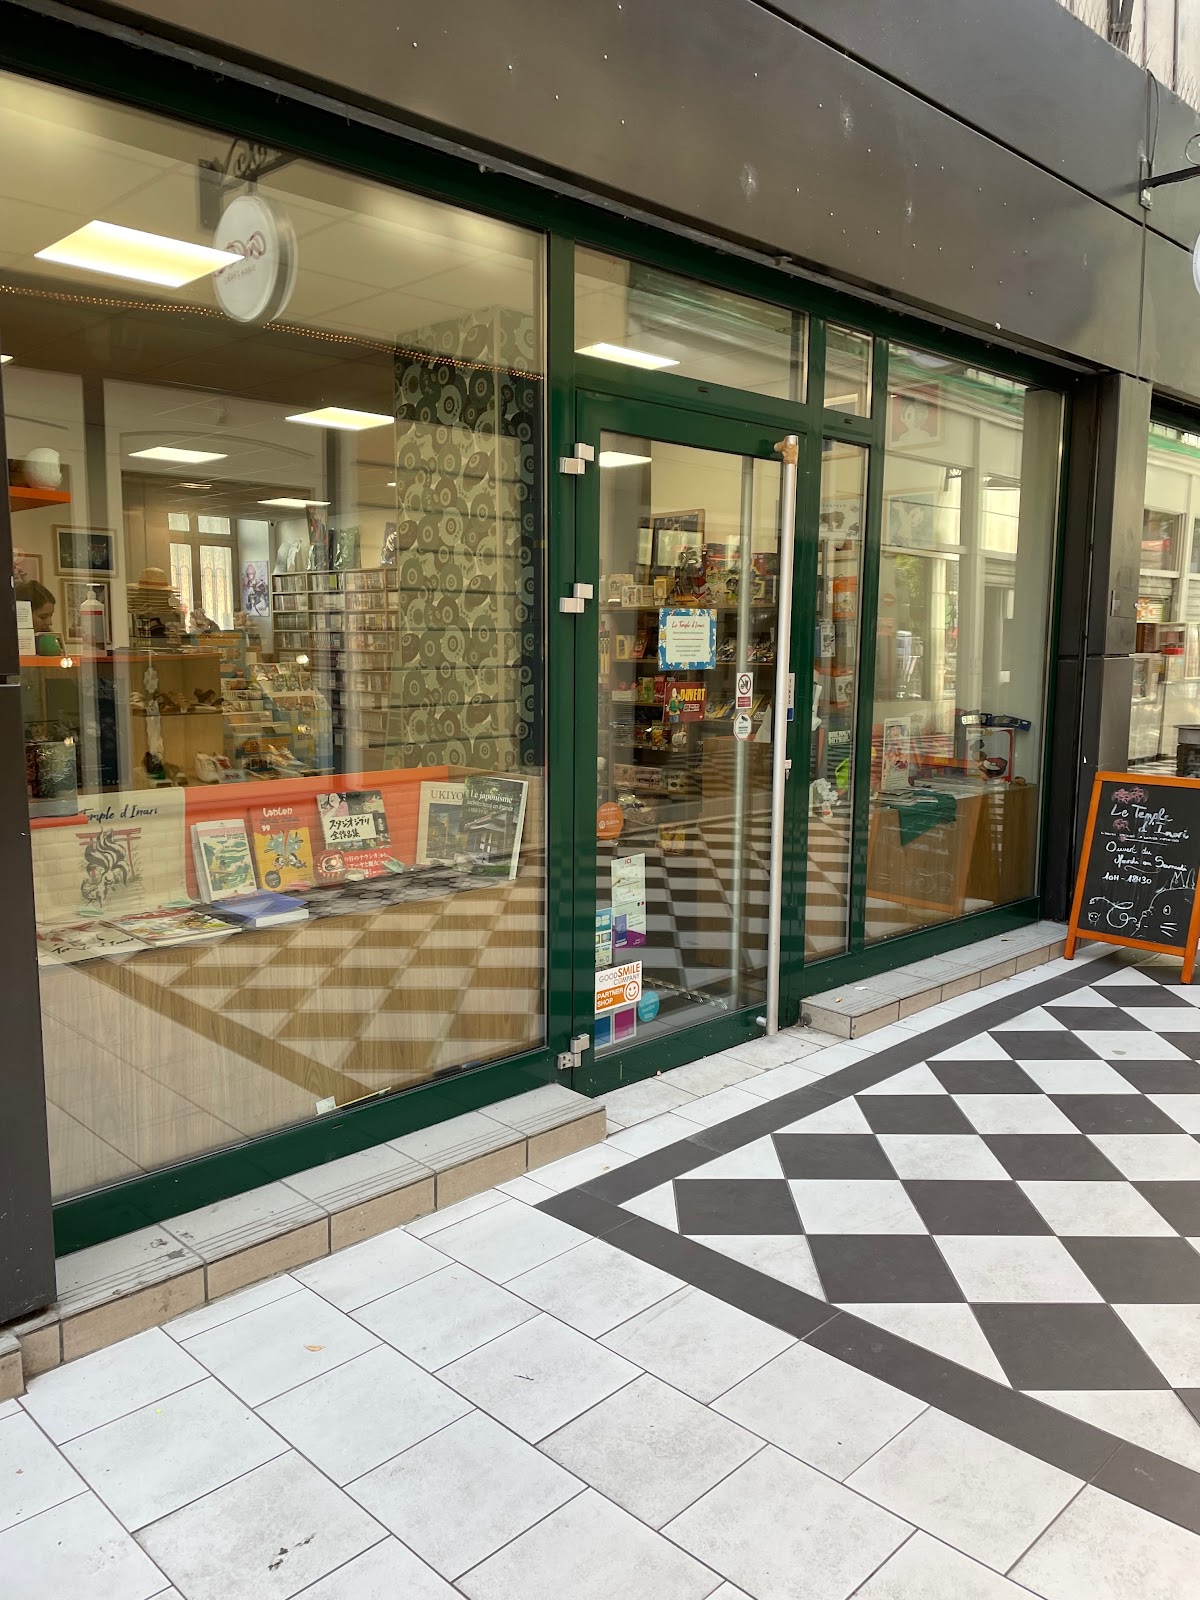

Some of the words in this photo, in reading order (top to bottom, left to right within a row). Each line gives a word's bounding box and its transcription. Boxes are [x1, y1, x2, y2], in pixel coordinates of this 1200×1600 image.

[680, 688, 706, 701] OUVERT
[470, 789, 479, 799] Le
[478, 790, 513, 805] japonisme
[1110, 803, 1129, 818] Le
[1131, 803, 1174, 826] Temple
[328, 815, 370, 831] スタジオジブリ
[1105, 840, 1138, 854] Ouvert
[1141, 846, 1153, 856] du
[1113, 853, 1140, 869] Mardi
[1154, 855, 1188, 872] Samedi
[1101, 871, 1120, 881] 10H
[1126, 874, 1153, 885] 18H30
[599, 971, 618, 983] GOOD
[617, 963, 641, 978] SMILE
[613, 973, 640, 986] COMPANY
[597, 987, 624, 1000] PARTNER
[597, 997, 614, 1008] SHOP
